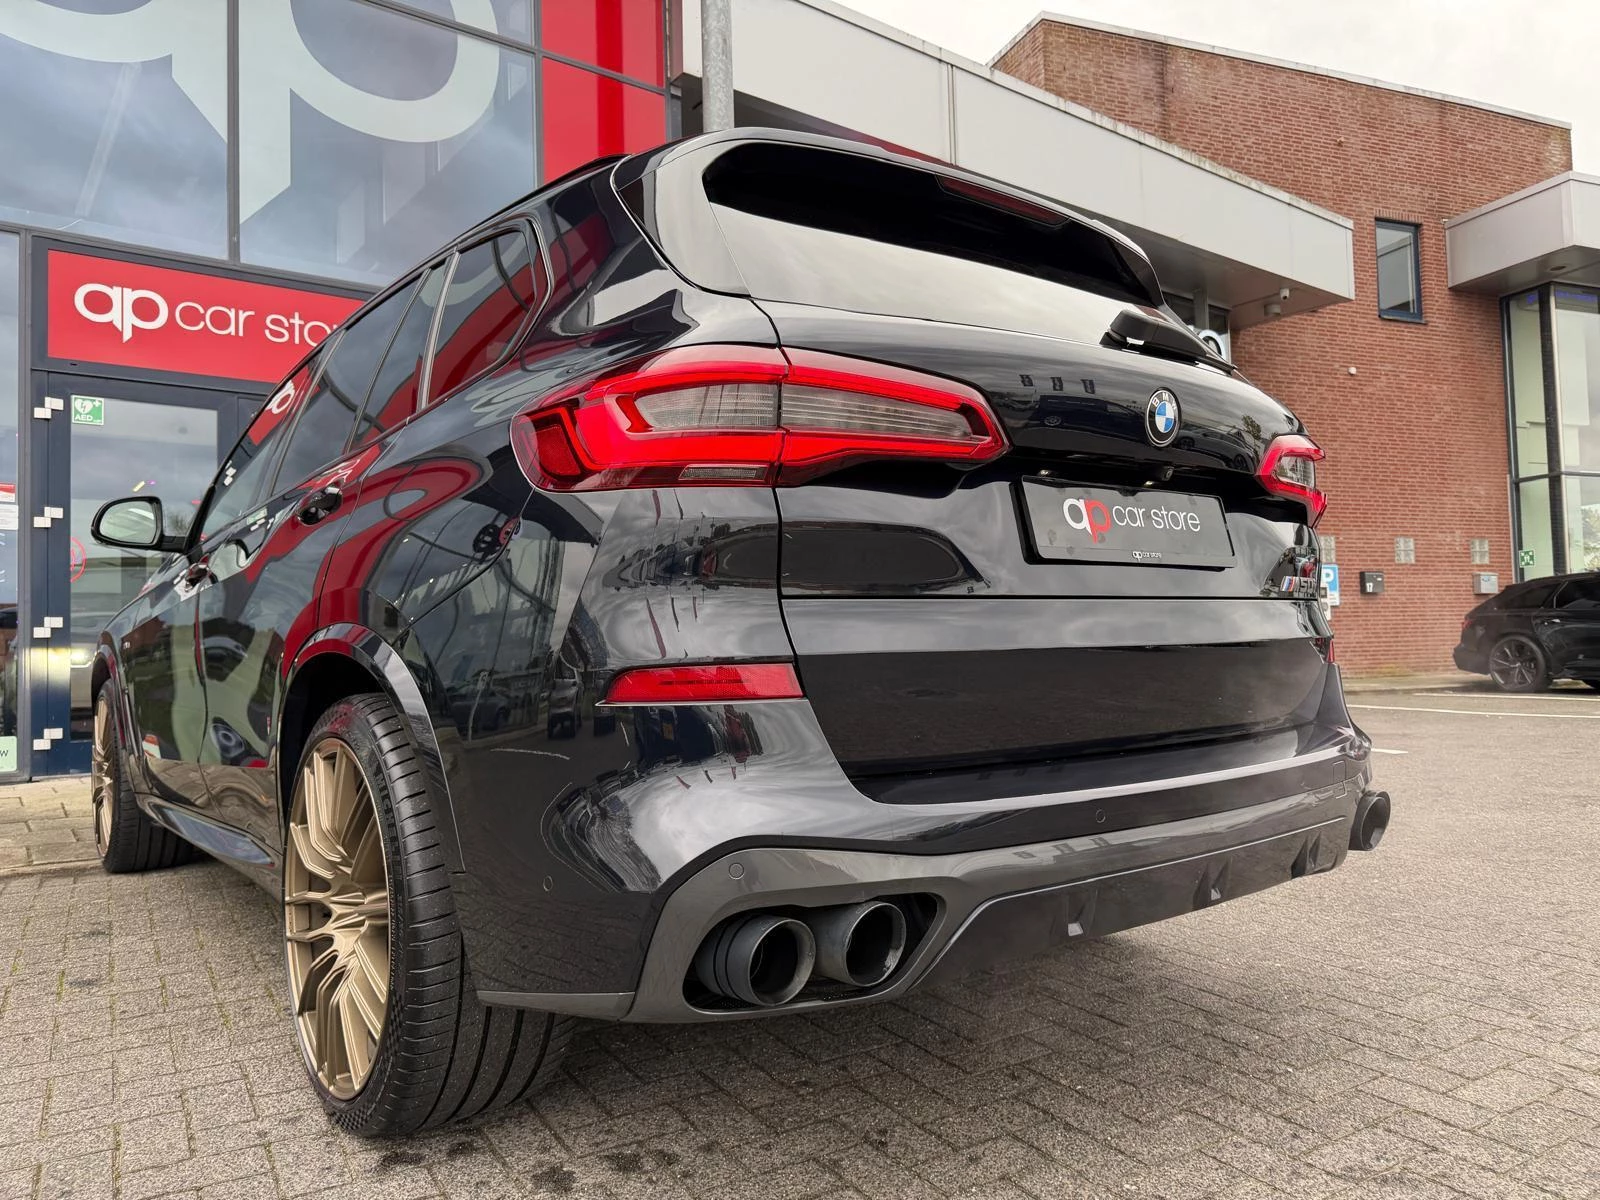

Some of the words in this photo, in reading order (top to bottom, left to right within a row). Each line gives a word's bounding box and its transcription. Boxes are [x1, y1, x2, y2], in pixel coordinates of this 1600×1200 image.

[74, 283, 169, 343] ap
[175, 301, 255, 337] car
[264, 311, 338, 348] sto
[1152, 392, 1177, 410] BMW
[75, 413, 93, 422] AED
[1062, 498, 1113, 544] ap
[1112, 505, 1146, 528] car
[1150, 505, 1201, 532] store
